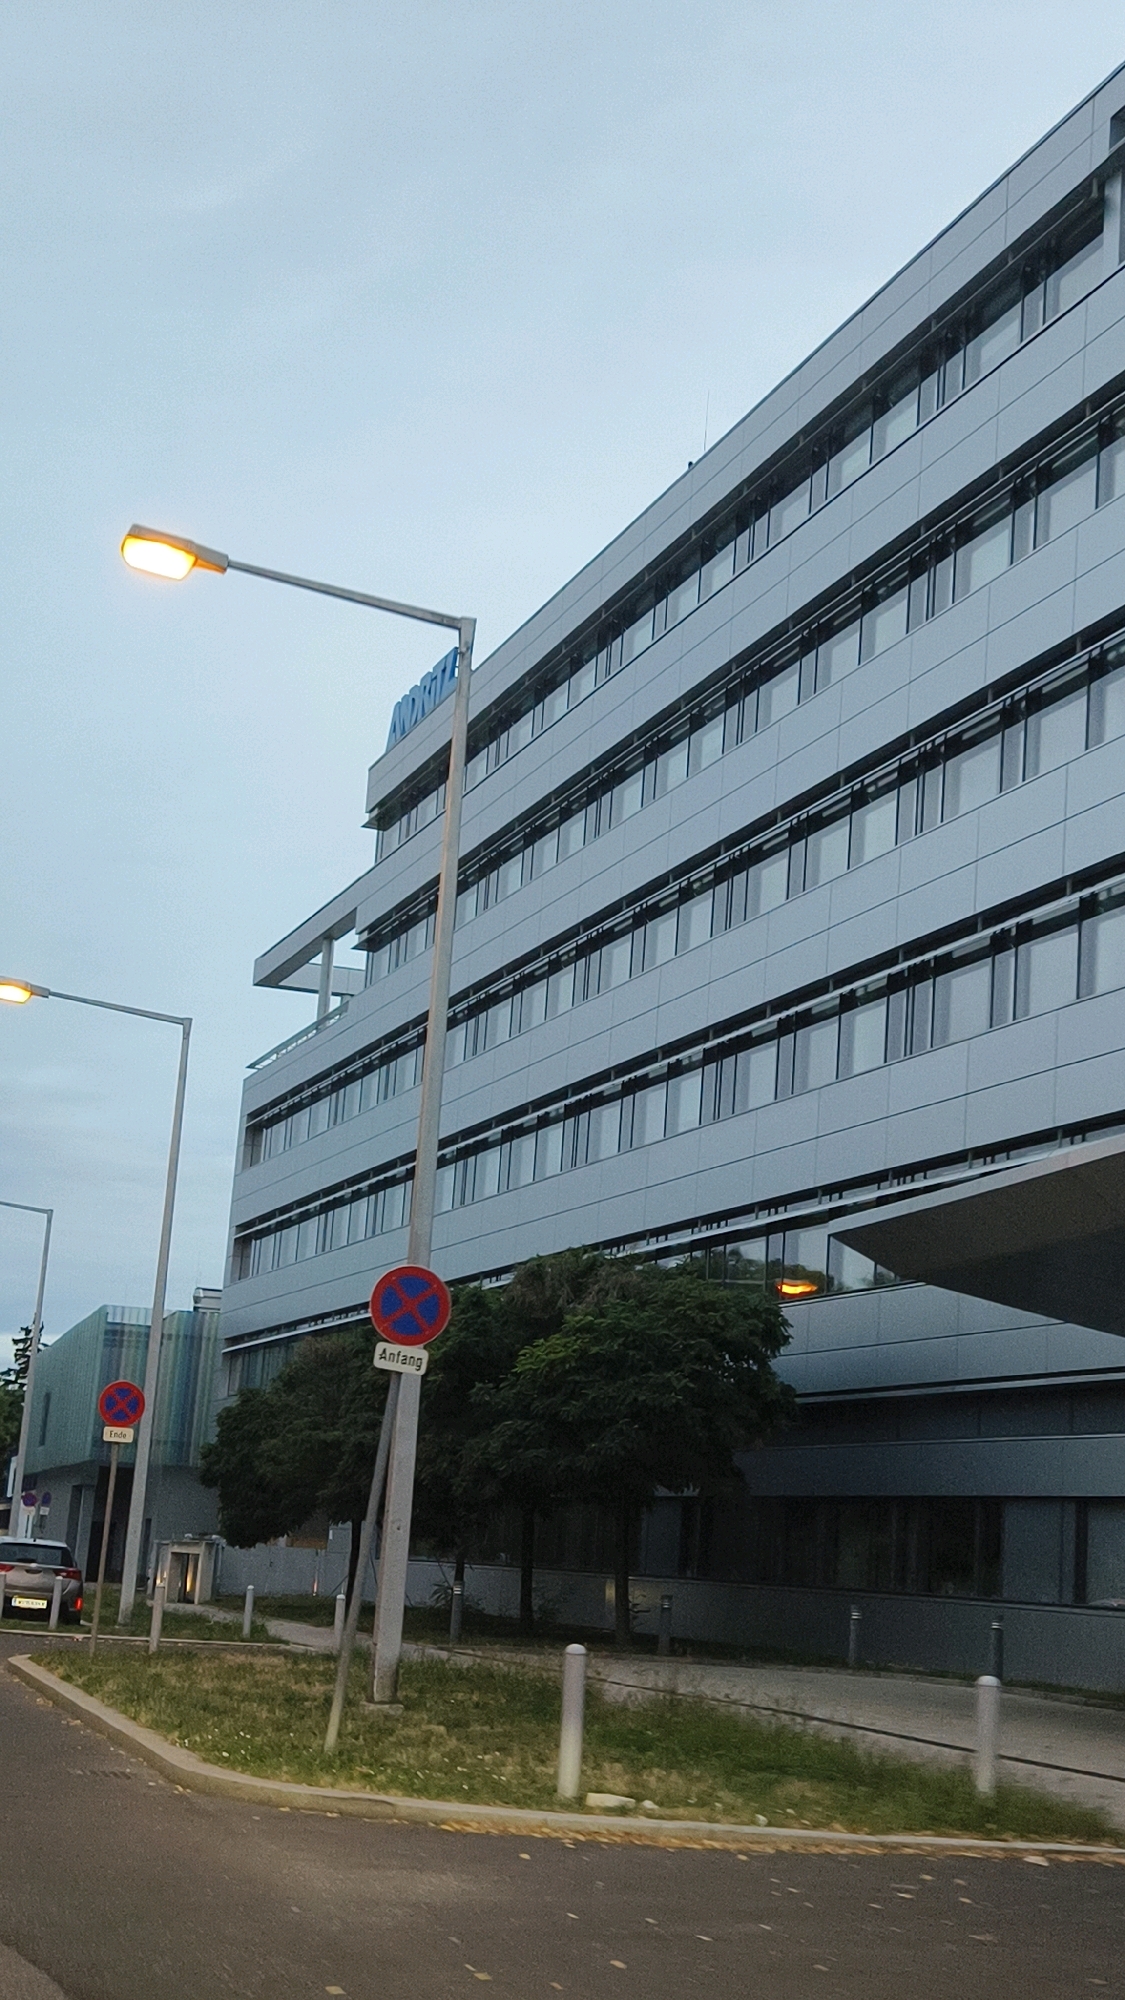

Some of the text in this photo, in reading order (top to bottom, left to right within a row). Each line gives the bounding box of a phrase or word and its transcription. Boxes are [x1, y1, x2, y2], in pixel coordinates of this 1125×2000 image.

[385, 646, 459, 752] ANDRITZ
[378, 1347, 423, 1372] Anfang
[109, 1430, 127, 1439] Ende
